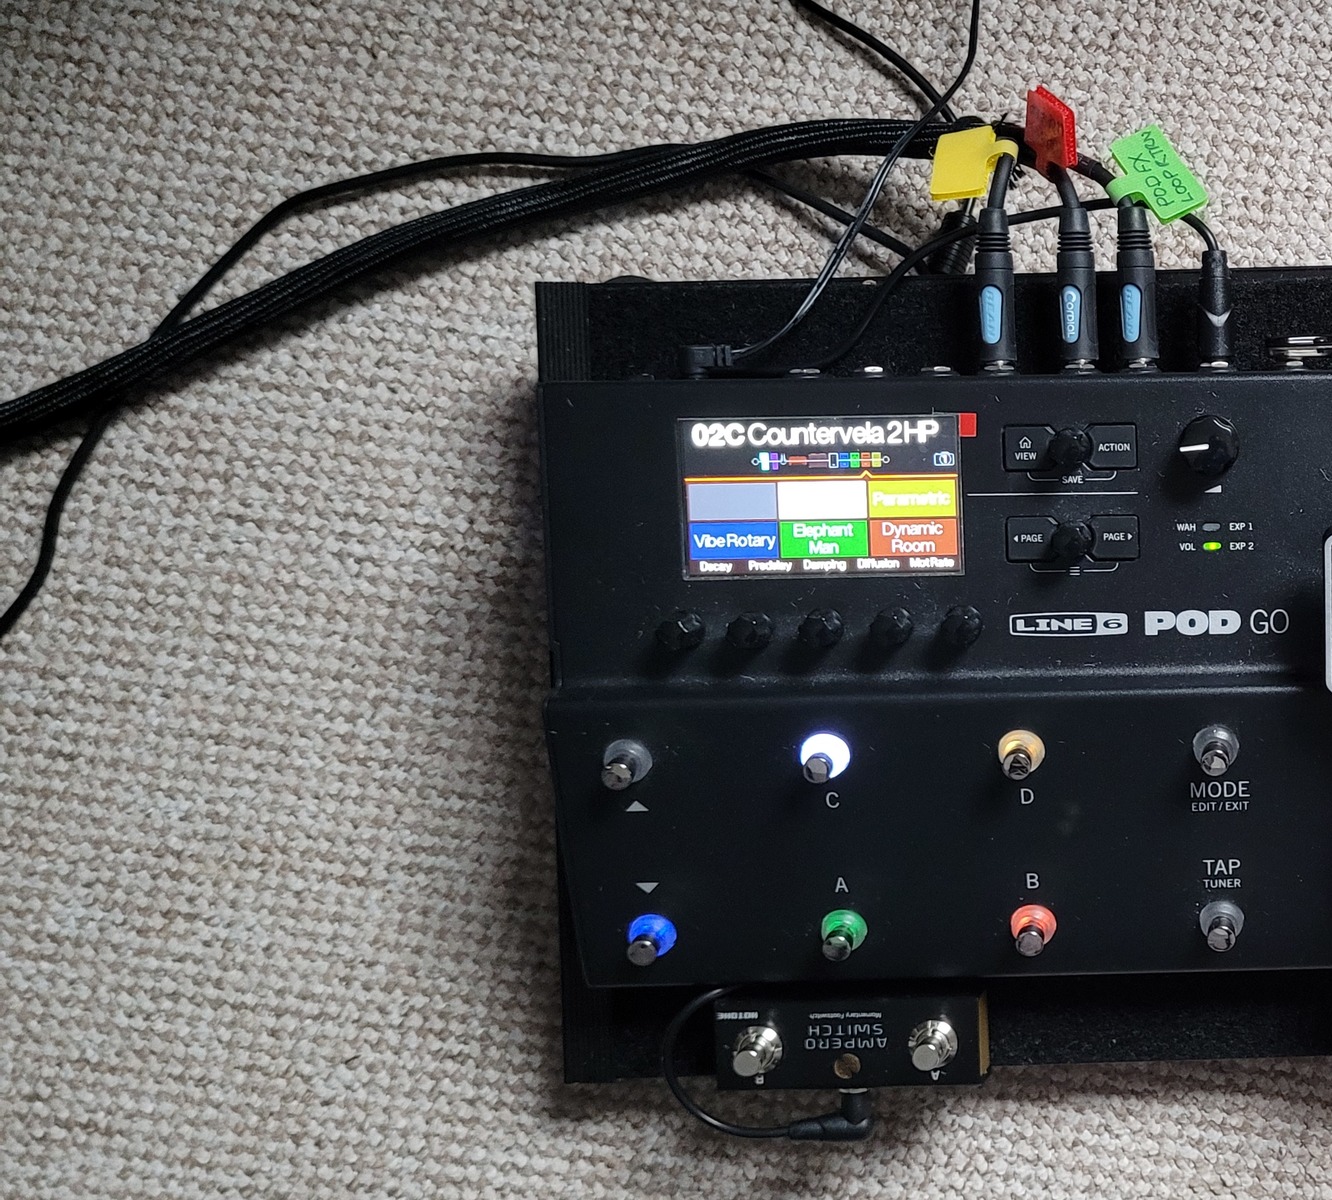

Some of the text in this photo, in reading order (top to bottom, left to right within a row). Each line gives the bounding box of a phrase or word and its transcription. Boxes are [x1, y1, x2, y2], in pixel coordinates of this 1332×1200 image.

[1128, 152, 1175, 207] POD FX
[691, 422, 745, 447] 02C
[747, 421, 885, 446] Countervela
[1098, 443, 1131, 452] ACTION
[1015, 452, 1037, 461] VIEW
[1061, 475, 1084, 484] SAVE
[872, 492, 951, 506] Parametric
[793, 522, 853, 539] Elephant
[881, 521, 943, 537] Dynamic
[1176, 522, 1253, 532] WAH EXP 1
[693, 533, 776, 551] Vibe Rotary
[1021, 534, 1043, 543] PAGE
[1103, 532, 1126, 541] PAGE
[808, 540, 839, 554] Man
[891, 539, 935, 553] Room
[1179, 542, 1254, 551] VOL EXP 2
[700, 560, 732, 573] Decay
[803, 560, 847, 572] Damping
[857, 558, 900, 569] Diffusion
[1016, 618, 1123, 631] LINE 6
[1144, 609, 1290, 636] POD GO
[1020, 788, 1034, 805] D
[1190, 781, 1250, 798] MODE
[825, 792, 840, 809] C
[1202, 859, 1241, 875] TAP
[834, 877, 849, 894] A
[1026, 873, 1039, 889] B
[1203, 879, 1241, 888] TUNER
[808, 1024, 883, 1036] SWITCH
[805, 1037, 887, 1049] AMPERO
[931, 1070, 940, 1080] A
